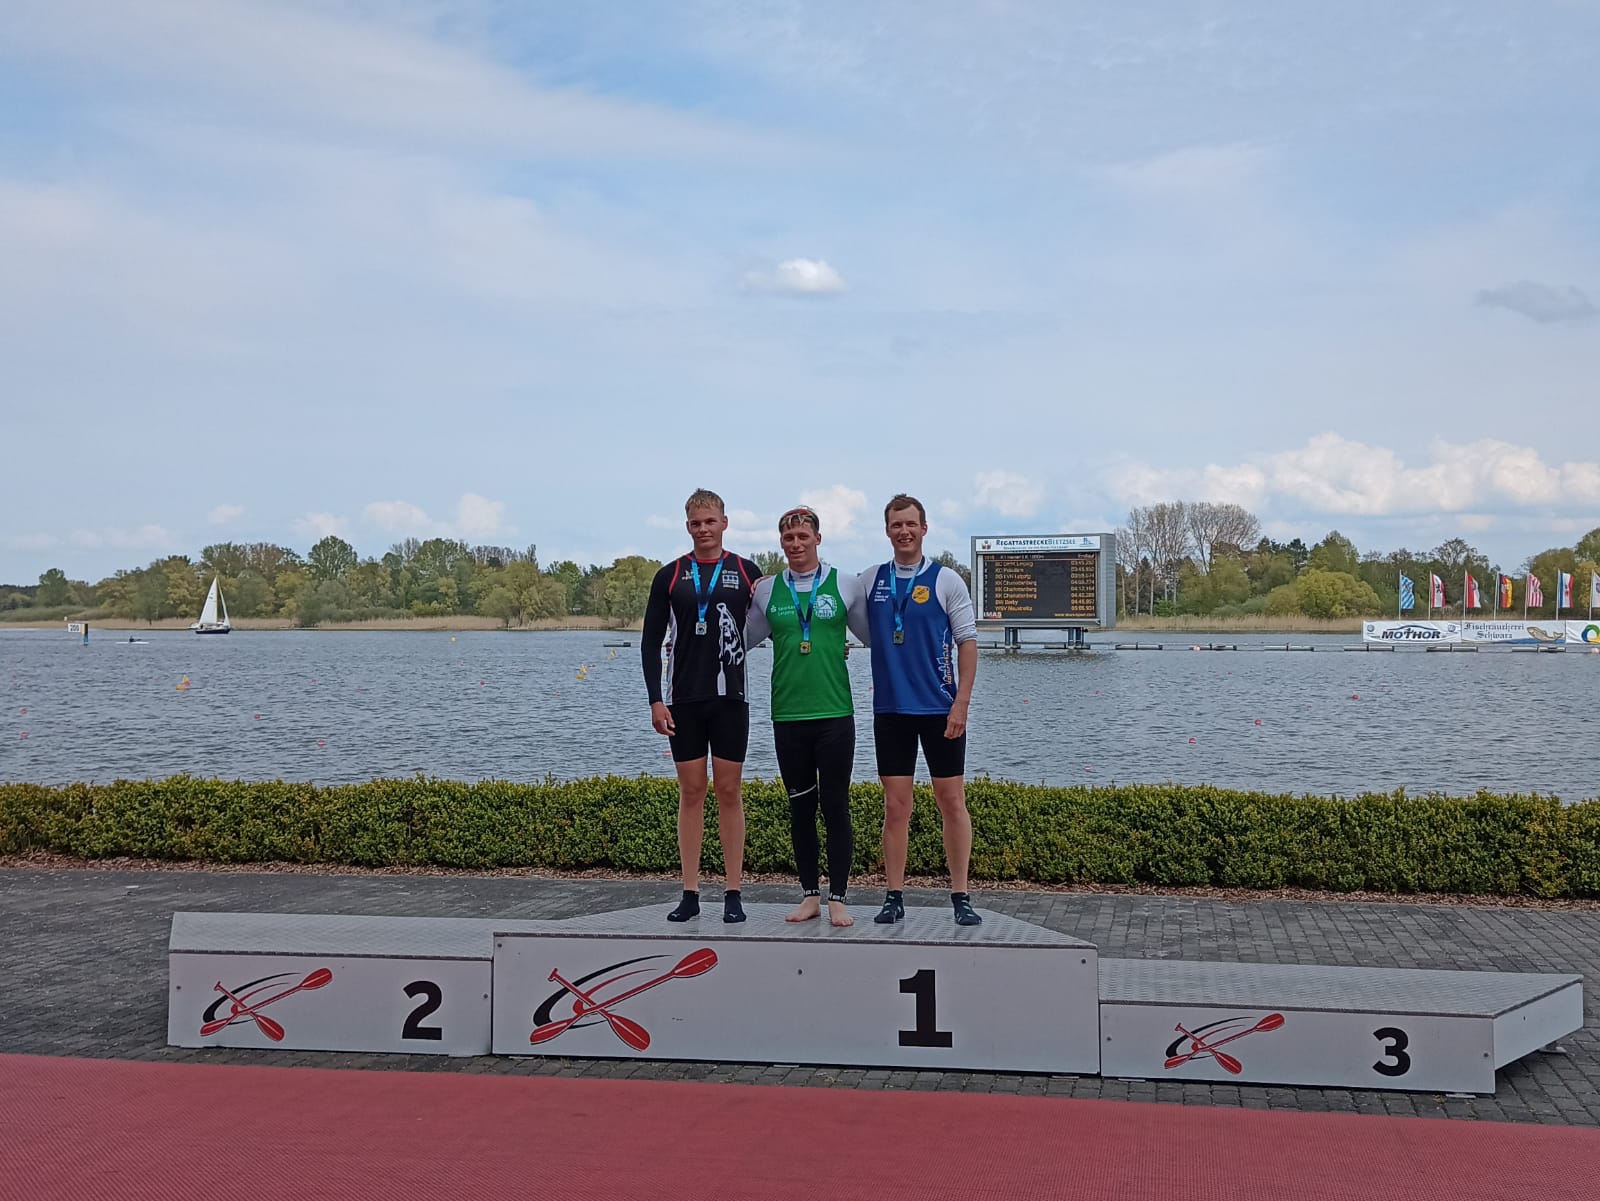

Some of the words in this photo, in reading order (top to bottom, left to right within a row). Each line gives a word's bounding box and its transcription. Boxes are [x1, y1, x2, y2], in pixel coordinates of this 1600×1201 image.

[1381, 627, 1441, 639] MOTHOR
[402, 980, 443, 1041] 2
[898, 969, 953, 1048] 1
[1372, 1027, 1411, 1076] 3
